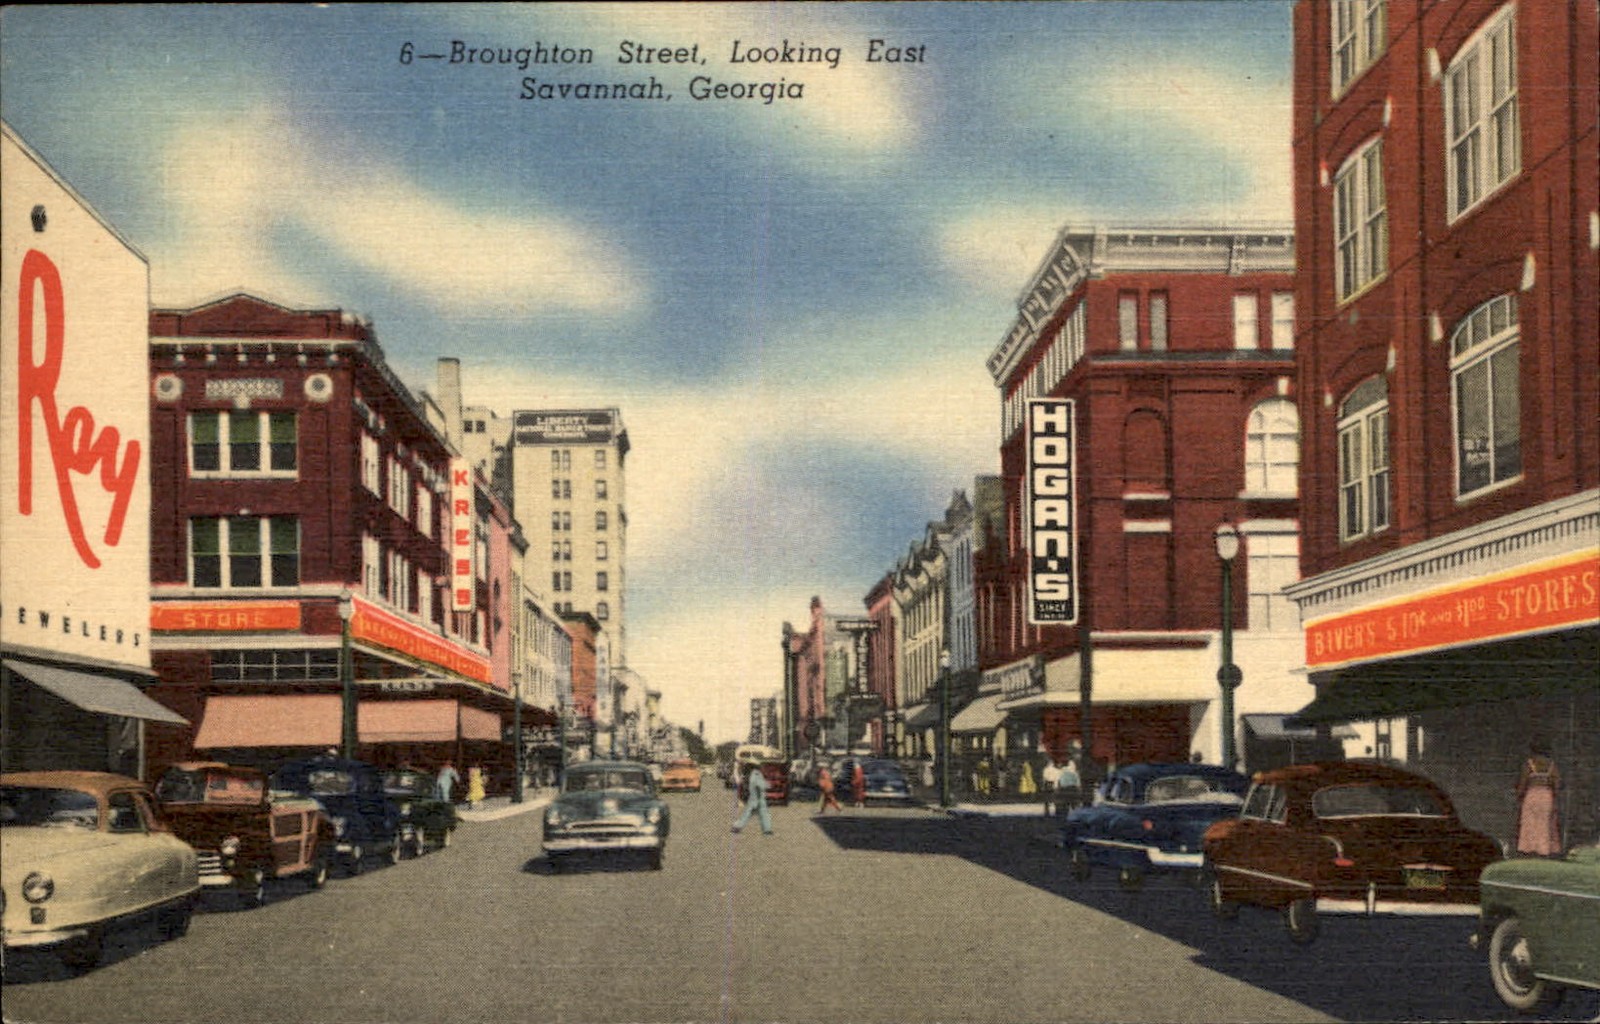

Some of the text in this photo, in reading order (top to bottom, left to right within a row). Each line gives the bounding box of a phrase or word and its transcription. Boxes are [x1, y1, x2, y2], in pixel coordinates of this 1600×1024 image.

[18, 249, 141, 569] Ray
[454, 469, 471, 606] KRESS
[182, 611, 264, 628] STORE
[1496, 570, 1596, 621] STORES
